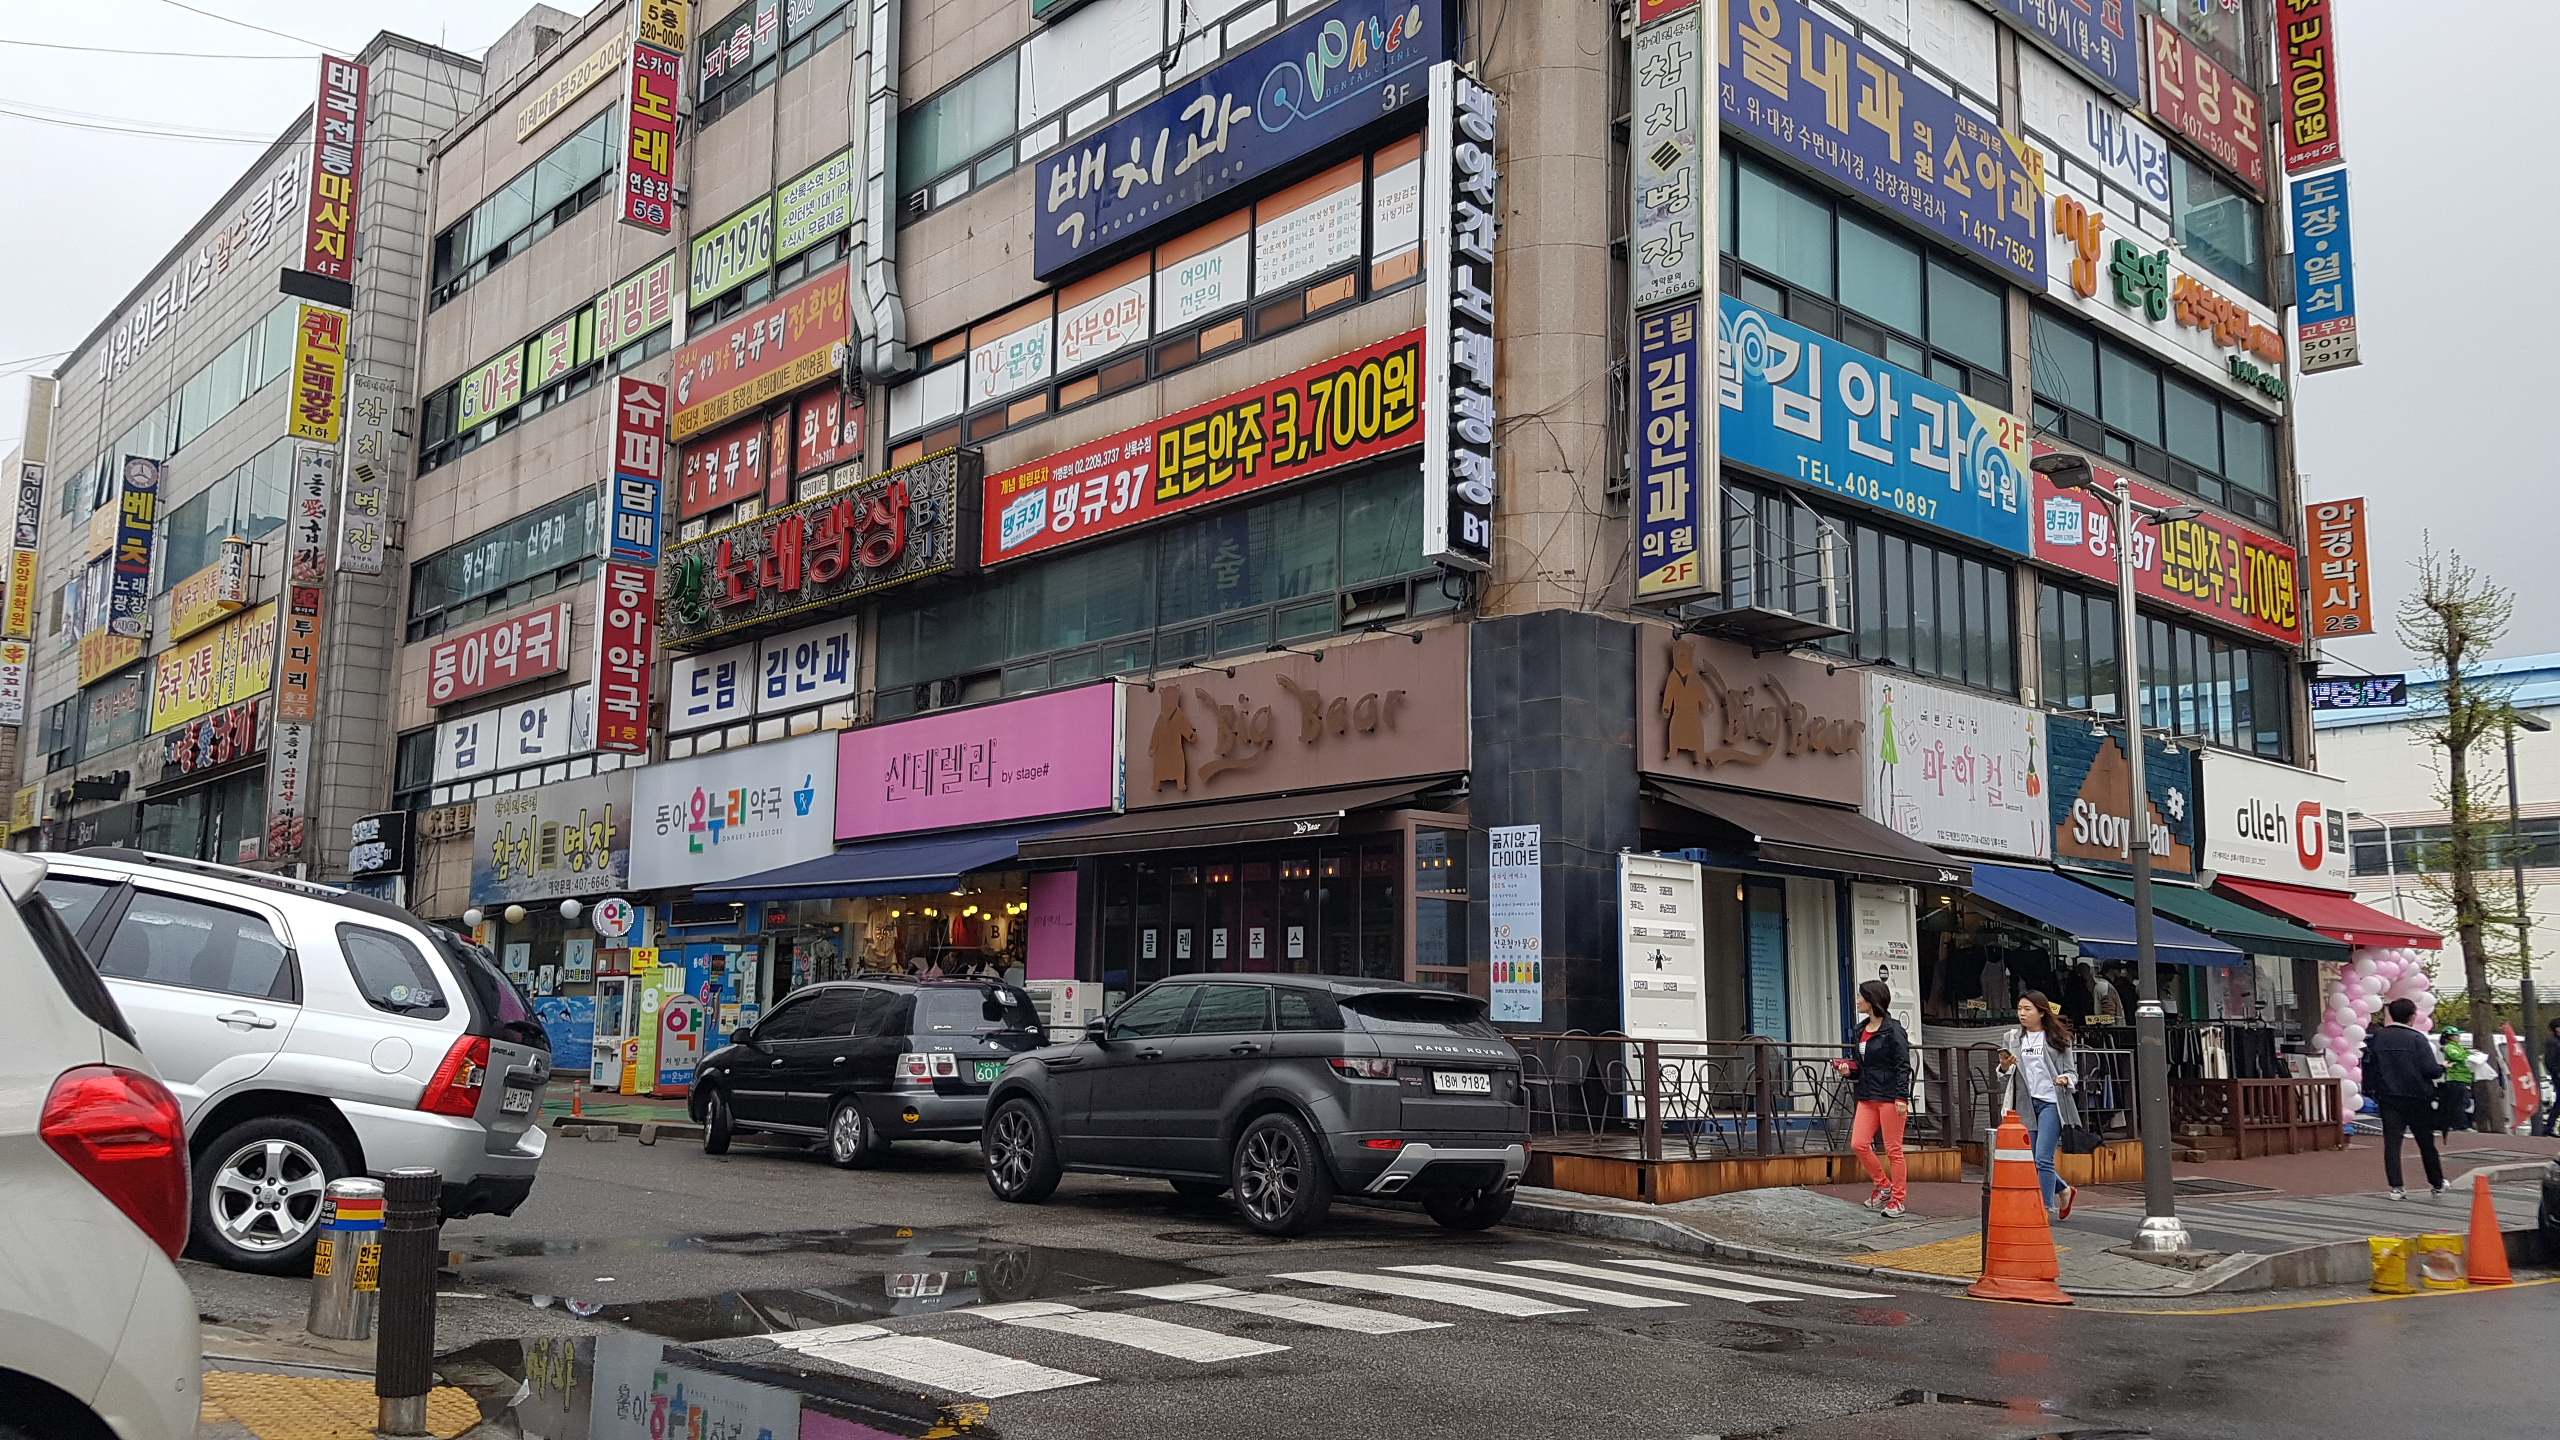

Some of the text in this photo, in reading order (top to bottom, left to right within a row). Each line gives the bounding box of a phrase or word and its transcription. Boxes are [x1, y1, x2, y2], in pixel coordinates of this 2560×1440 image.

[640, 20, 685, 51] 520-0000
[648, 4, 679, 28] 5층
[704, 2, 779, 82] 파출부
[1305, 3, 1424, 103] White
[635, 52, 676, 80] 스카이
[1324, 68, 1372, 99] DENTAL
[1639, 41, 1693, 137] 참치
[2155, 23, 2260, 155] 전당포
[2289, 16, 2329, 148] 3,700원
[1381, 82, 1412, 112] 3F
[632, 75, 673, 176] 노래
[1953, 111, 2003, 158] 진료과목
[314, 62, 360, 261] 태국전통마사지
[1046, 91, 1254, 250] 백치과
[2020, 145, 2045, 178] 4F
[2085, 99, 2171, 203] 내시경
[2249, 157, 2265, 183] 4F
[629, 172, 670, 202] 연습장
[1872, 163, 1948, 226] 심장정밀검사
[1942, 134, 2038, 240] 소아과
[633, 199, 665, 225] 5층
[1380, 201, 1415, 223] 지정기관
[692, 205, 772, 297] 407-1976
[1958, 208, 2036, 274] T.417-7582
[317, 259, 341, 276] 4F
[1179, 255, 1223, 288] 여의사
[1637, 278, 1697, 304] 407-6646
[1650, 271, 1682, 288] 예약문의
[2110, 236, 2170, 323] 문영
[1178, 281, 1222, 317] 전문의
[731, 307, 786, 371] 컴퓨터
[787, 276, 846, 343] 전화방
[1061, 294, 1149, 359] 산부인과
[1642, 309, 1694, 353] 드림
[2300, 316, 2357, 341] 고무인
[2303, 335, 2351, 352] 501-
[481, 350, 521, 416] 아주
[547, 320, 570, 380] 굿
[679, 347, 698, 370] 24시
[831, 346, 844, 366] 3F
[1005, 333, 1047, 380] 문영
[2303, 347, 2356, 366] 7917
[299, 424, 330, 440] 지하
[357, 397, 388, 462] 참치
[620, 384, 663, 478] 슈퍼
[845, 424, 858, 441] 3F
[1761, 330, 1967, 494] 김안과
[1998, 415, 2026, 456] 2F
[1051, 349, 1417, 535] 땡큐37 모든안주 3,700원
[1646, 352, 1691, 524] 김안과
[704, 429, 764, 497] 컴퓨터
[1000, 475, 1017, 497] 개념
[1018, 466, 1050, 491] 힐링포차
[1123, 435, 1153, 461] 상록수점
[1796, 454, 1939, 521] TEL.408-0897
[1977, 468, 2018, 515] 의원
[617, 478, 657, 549] 담배
[1002, 498, 1046, 540] 땡큐37
[1462, 510, 1490, 549] B1
[2045, 509, 2081, 532] 땡큐37
[462, 512, 567, 584] 정신과 신경과
[712, 480, 911, 612] 노래광장
[1642, 525, 1693, 558] 의원
[2316, 503, 2362, 611] 안경박사
[115, 576, 147, 594] 노래
[1660, 561, 1694, 585] 2F
[2160, 519, 2297, 629] 모든안주 3,700원
[114, 594, 146, 614] 광장
[2324, 613, 2363, 633] 2층
[288, 618, 315, 691] 투다리
[432, 611, 553, 701] 동아약국
[604, 569, 648, 723] 동아약국
[158, 660, 183, 716] 중국
[187, 645, 213, 704] 전통
[687, 632, 850, 718] 드림 김안과
[282, 704, 309, 719] 소주
[1275, 672, 1407, 745] Bear
[1766, 672, 1867, 757] Bear
[607, 725, 638, 742] 1층
[883, 737, 1052, 804] 신데렐라 by stage#
[1922, 738, 2004, 808] 마이걸
[1491, 830, 1539, 850] 굶지않고
[2236, 797, 2289, 846] olleh
[491, 813, 538, 883] 참치
[1491, 849, 1540, 868] 다이어트
[603, 903, 628, 932] 약
[666, 1007, 703, 1052] 약
[1414, 1044, 1505, 1057] RANGE ROVER
[1461, 1075, 1486, 1091] 9182
